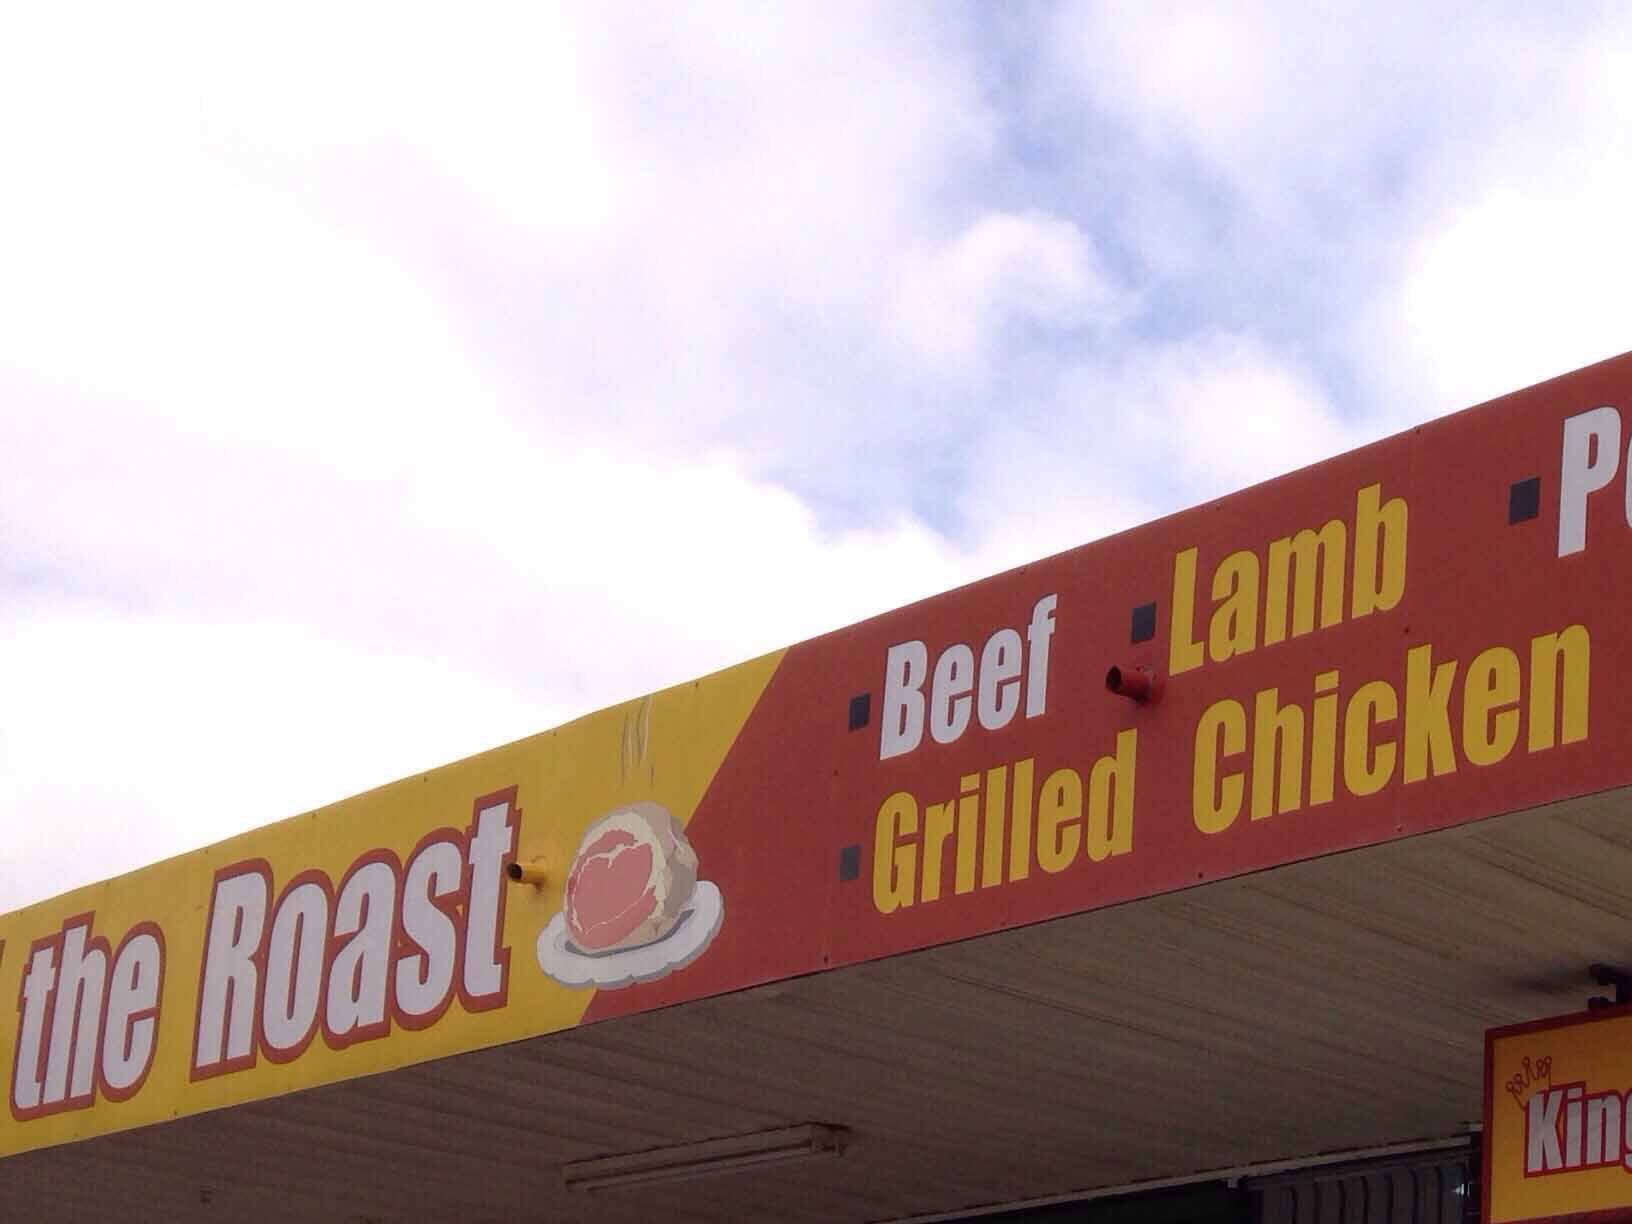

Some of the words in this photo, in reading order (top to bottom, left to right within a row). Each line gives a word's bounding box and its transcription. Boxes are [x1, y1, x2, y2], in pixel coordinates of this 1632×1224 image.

[880, 595, 1057, 760] Beef
[1169, 483, 1408, 676] Lamb
[873, 729, 1137, 914] Grilled
[1193, 623, 1590, 834] Chicken
[12, 914, 164, 1116] the
[193, 793, 518, 1076] Roast
